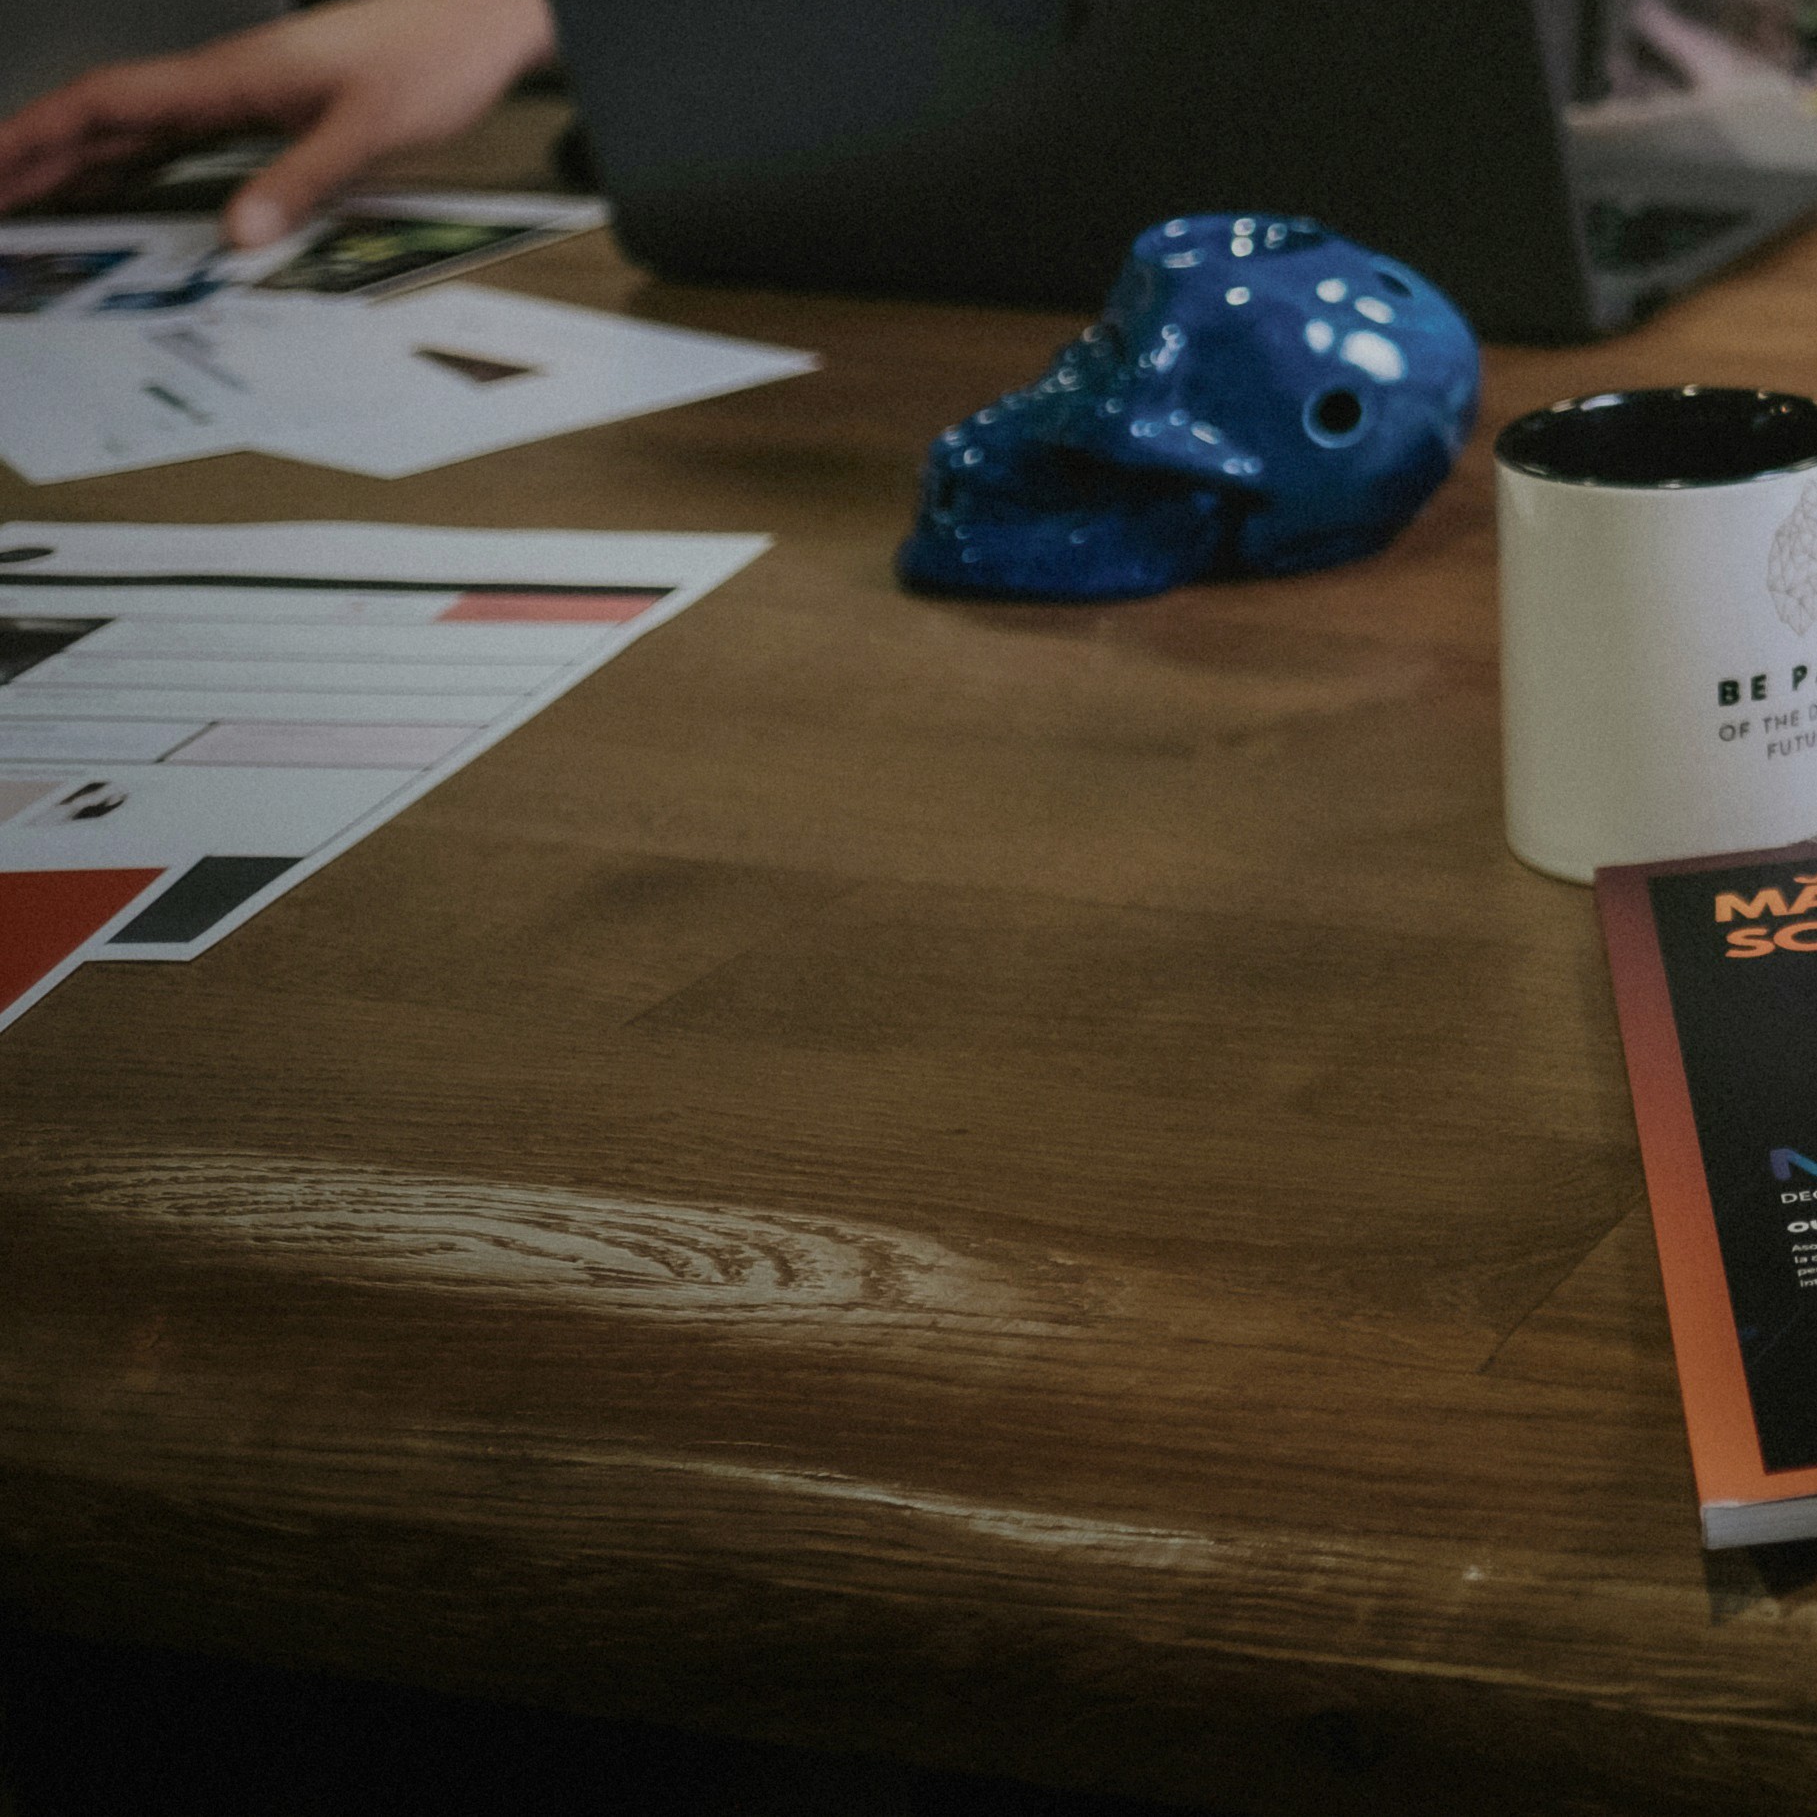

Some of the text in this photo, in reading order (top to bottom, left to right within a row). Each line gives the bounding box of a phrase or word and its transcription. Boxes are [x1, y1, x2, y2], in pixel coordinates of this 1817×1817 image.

[1718, 674, 1767, 707] BE
[1718, 721, 1750, 742] OF
[1762, 710, 1800, 734] THE
